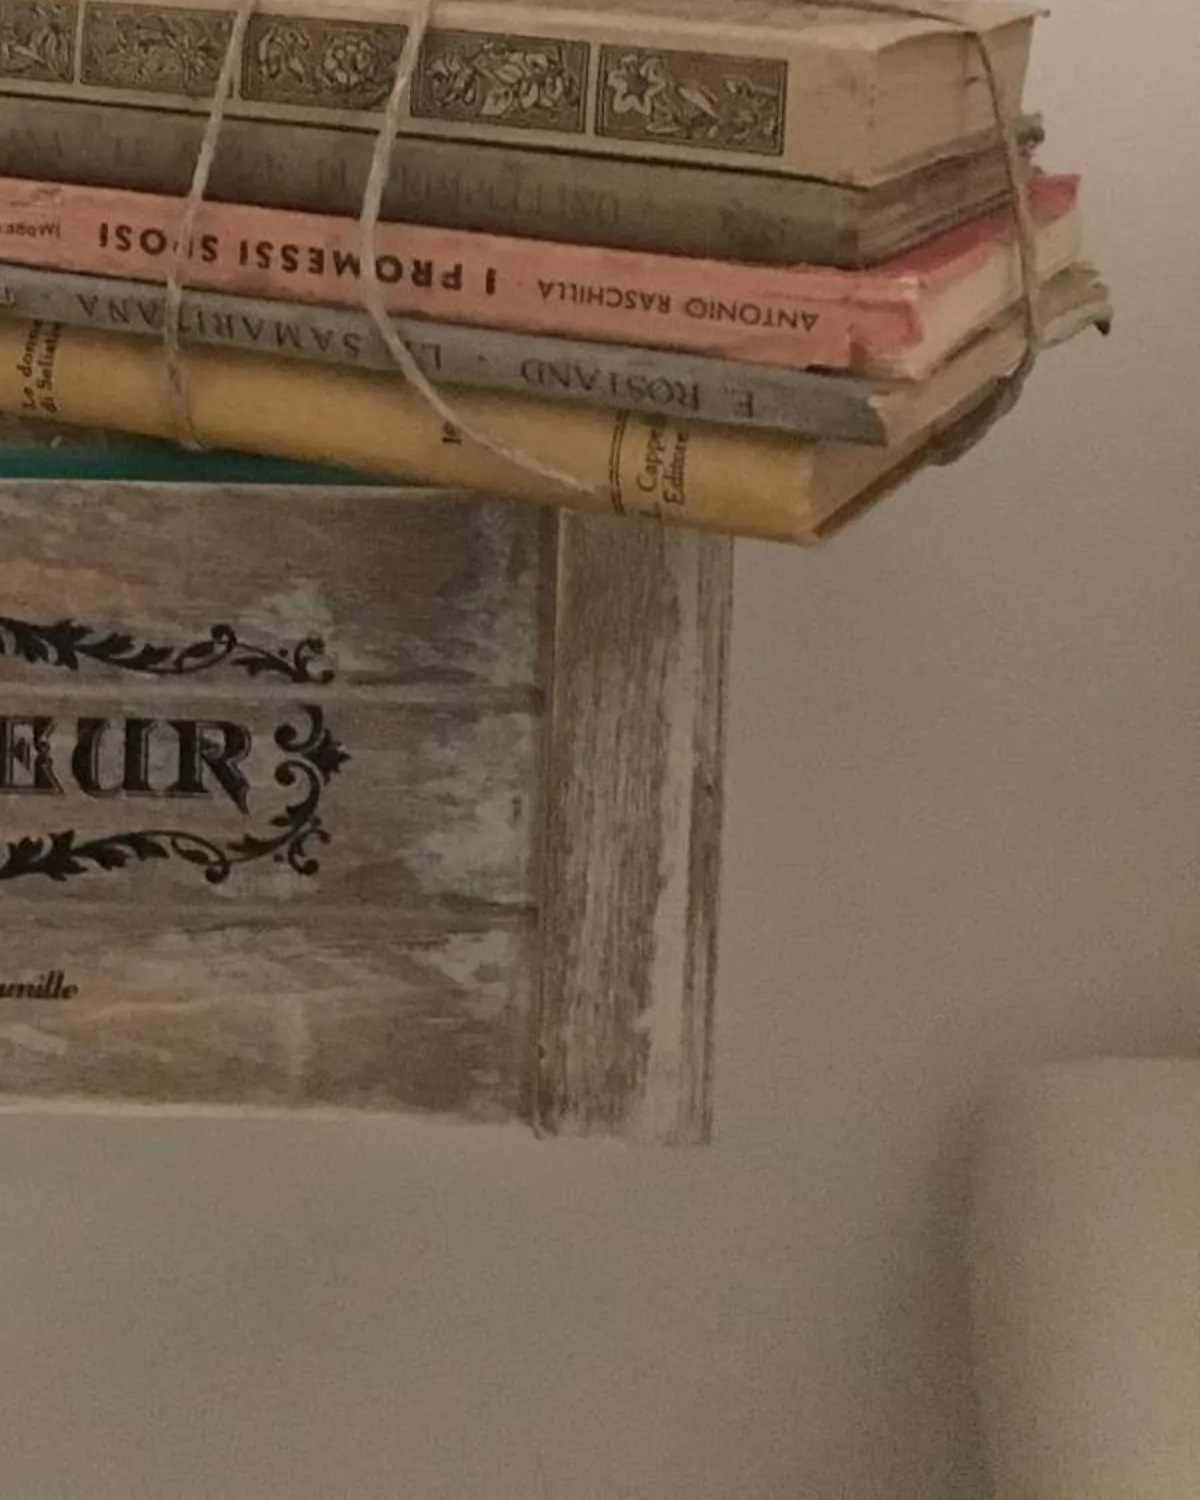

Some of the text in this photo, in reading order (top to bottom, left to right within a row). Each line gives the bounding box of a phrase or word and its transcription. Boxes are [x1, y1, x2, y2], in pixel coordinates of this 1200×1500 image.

[240, 239, 463, 295] PROMESSI
[485, 269, 497, 296] I
[537, 278, 819, 333] ANTONIO RASCHILLA
[521, 357, 700, 412] ROSTAND
[662, 431, 689, 506] Editore
